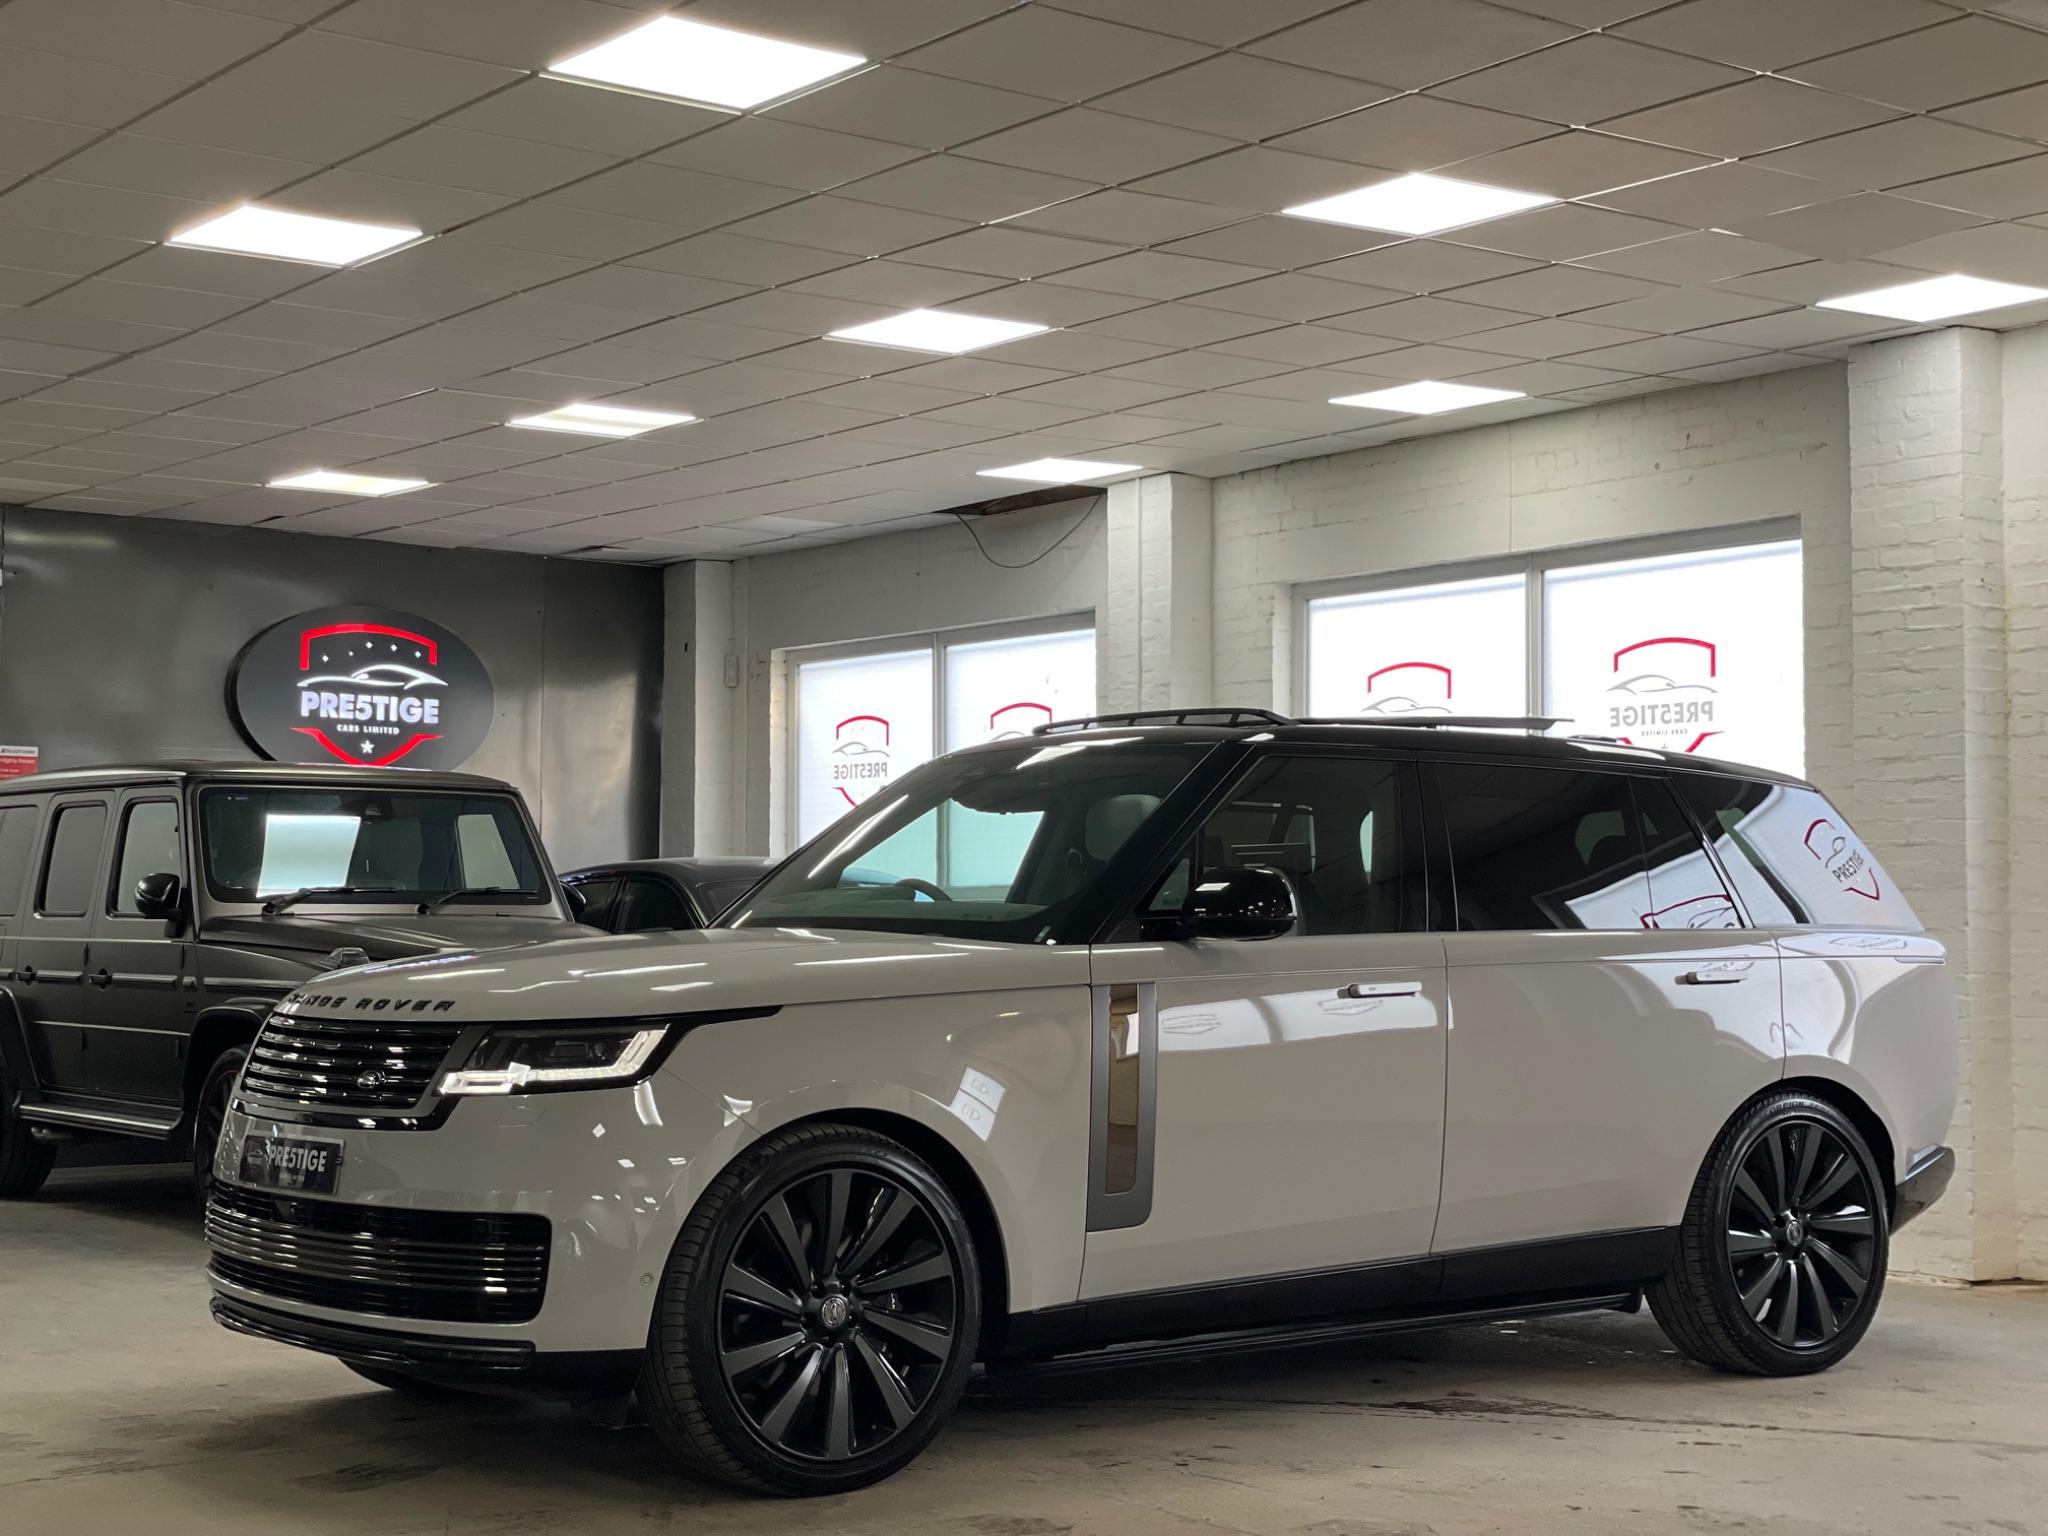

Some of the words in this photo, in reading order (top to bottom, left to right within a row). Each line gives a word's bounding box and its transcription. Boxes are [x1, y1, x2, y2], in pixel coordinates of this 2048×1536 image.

[337, 724, 360, 733] CARS
[363, 725, 400, 735] LIMITED
[355, 998, 456, 1012] ROVER
